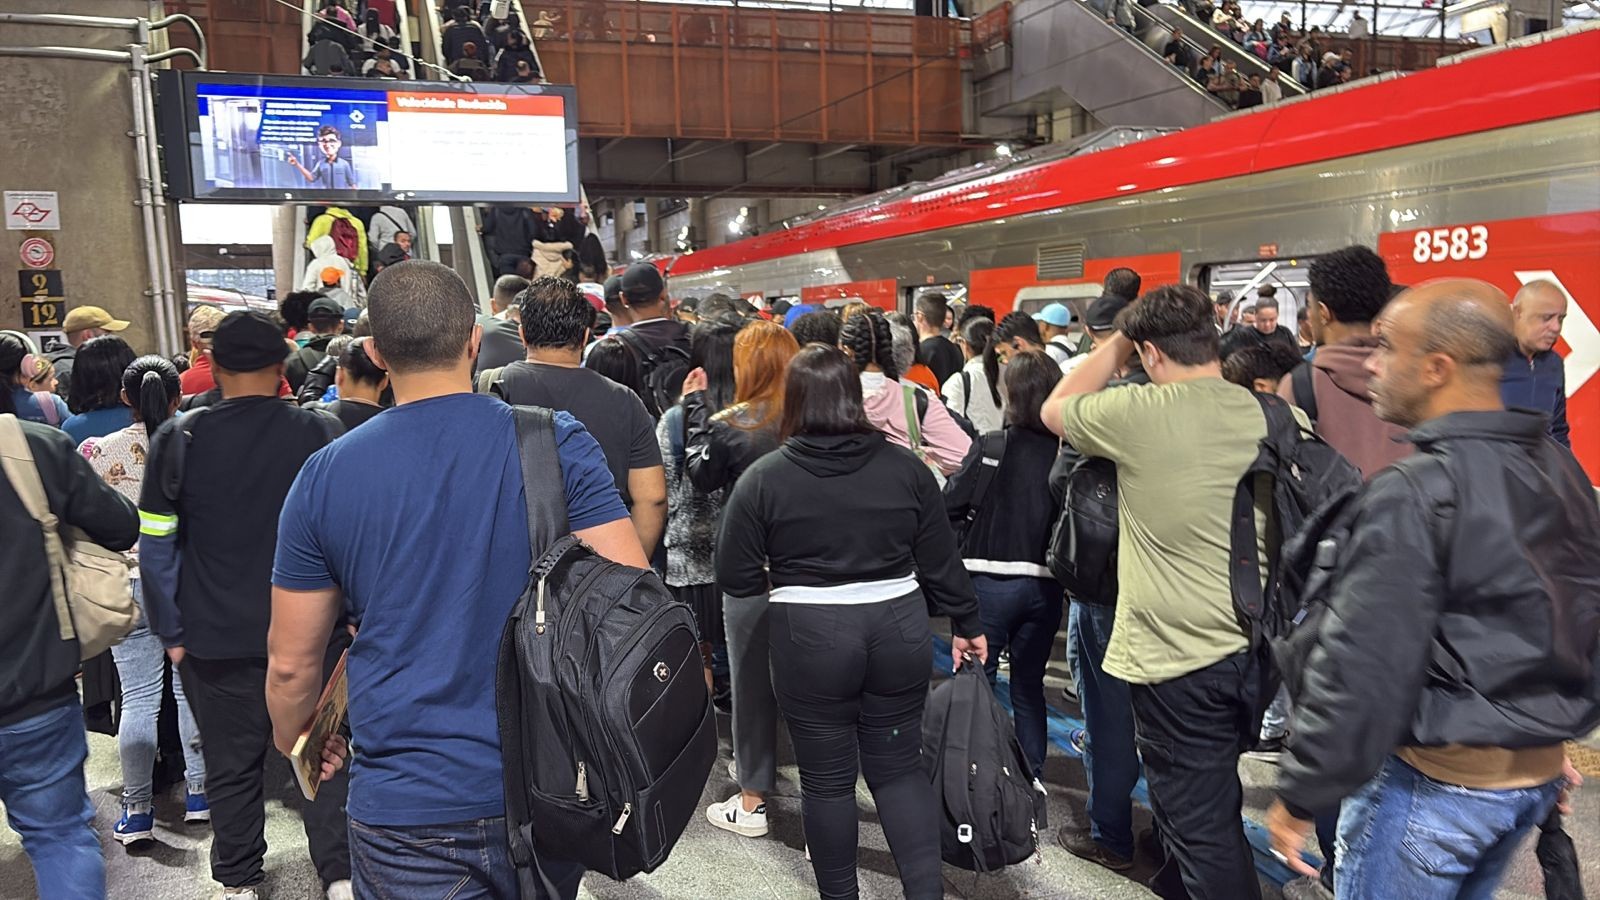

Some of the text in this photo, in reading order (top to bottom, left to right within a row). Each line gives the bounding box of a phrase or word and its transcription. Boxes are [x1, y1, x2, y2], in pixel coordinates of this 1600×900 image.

[1413, 225, 1488, 263] 8583
[32, 274, 49, 295] 2
[31, 304, 58, 326] 12
